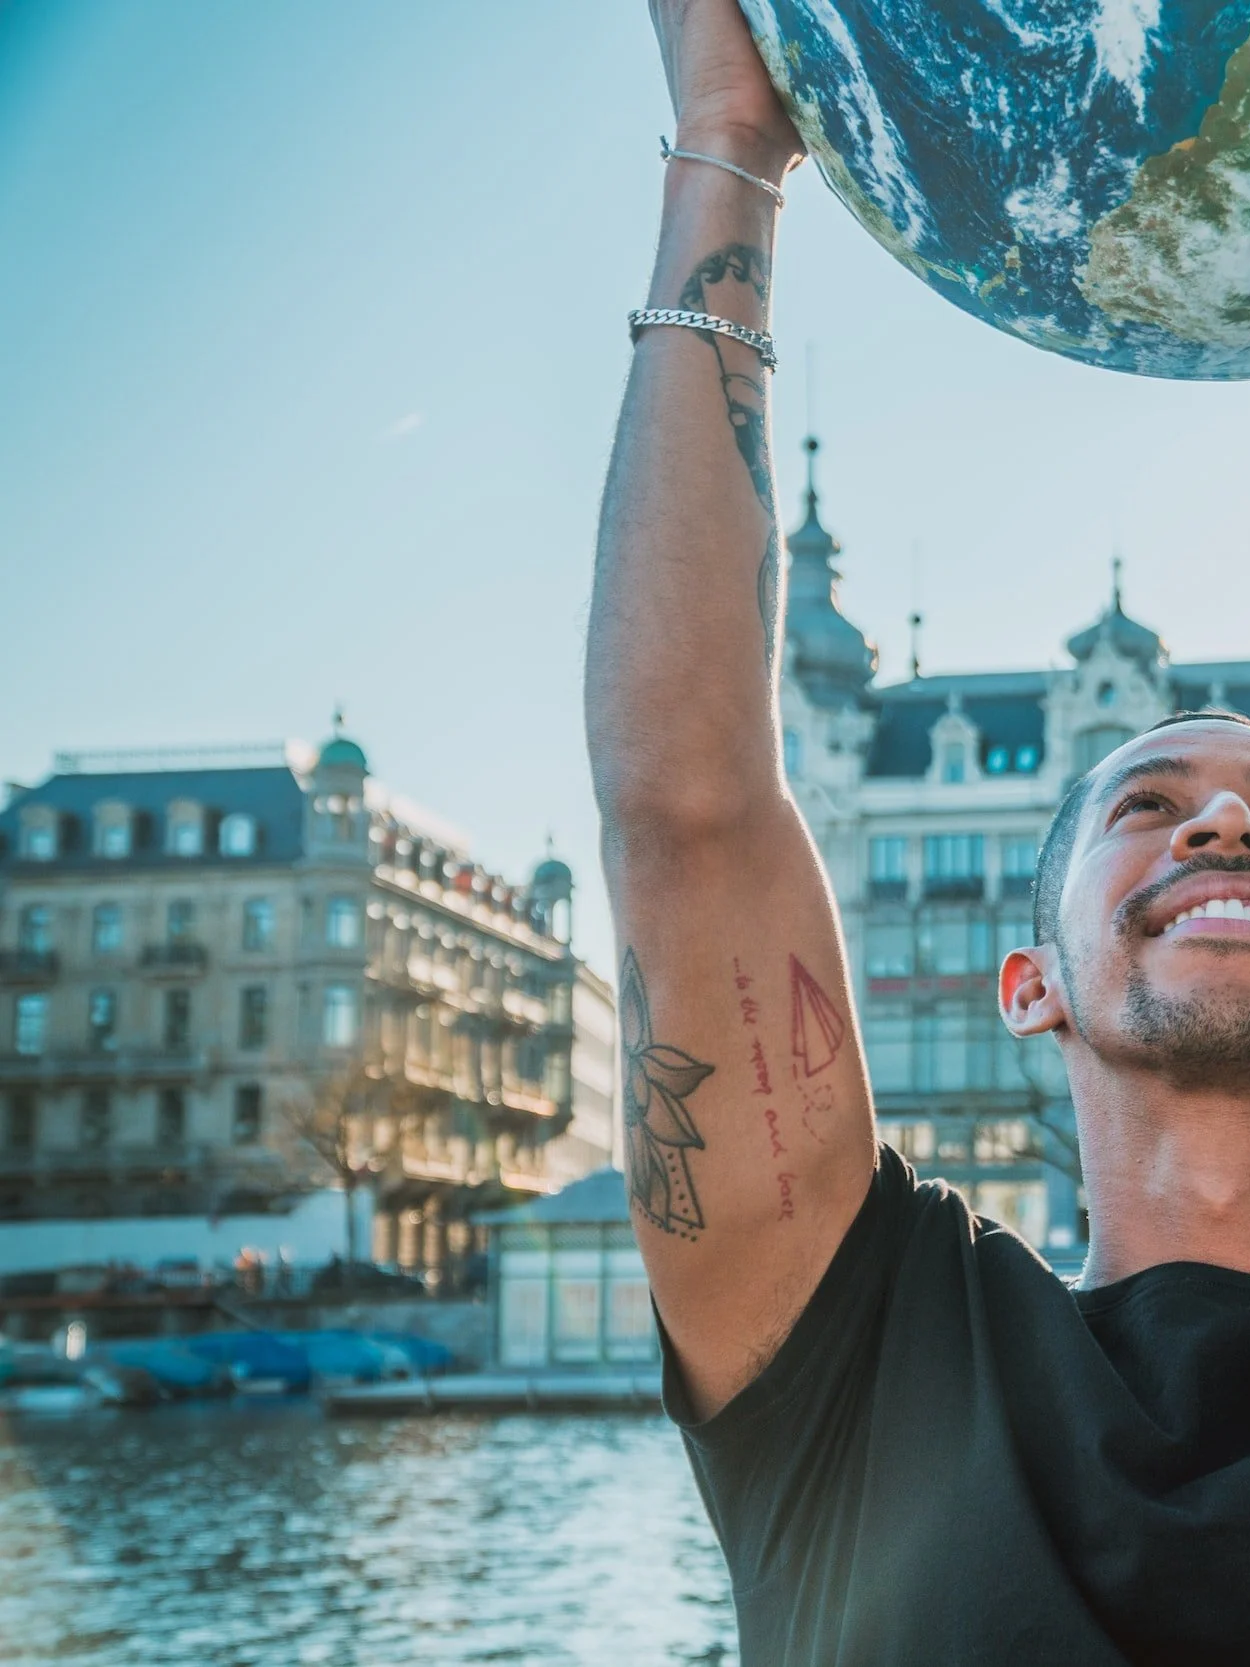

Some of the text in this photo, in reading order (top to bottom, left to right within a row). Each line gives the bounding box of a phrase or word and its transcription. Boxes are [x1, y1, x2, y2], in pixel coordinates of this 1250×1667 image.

[740, 997, 758, 1025] the
[764, 1109, 787, 1158] and
[777, 1172, 798, 1222] back
